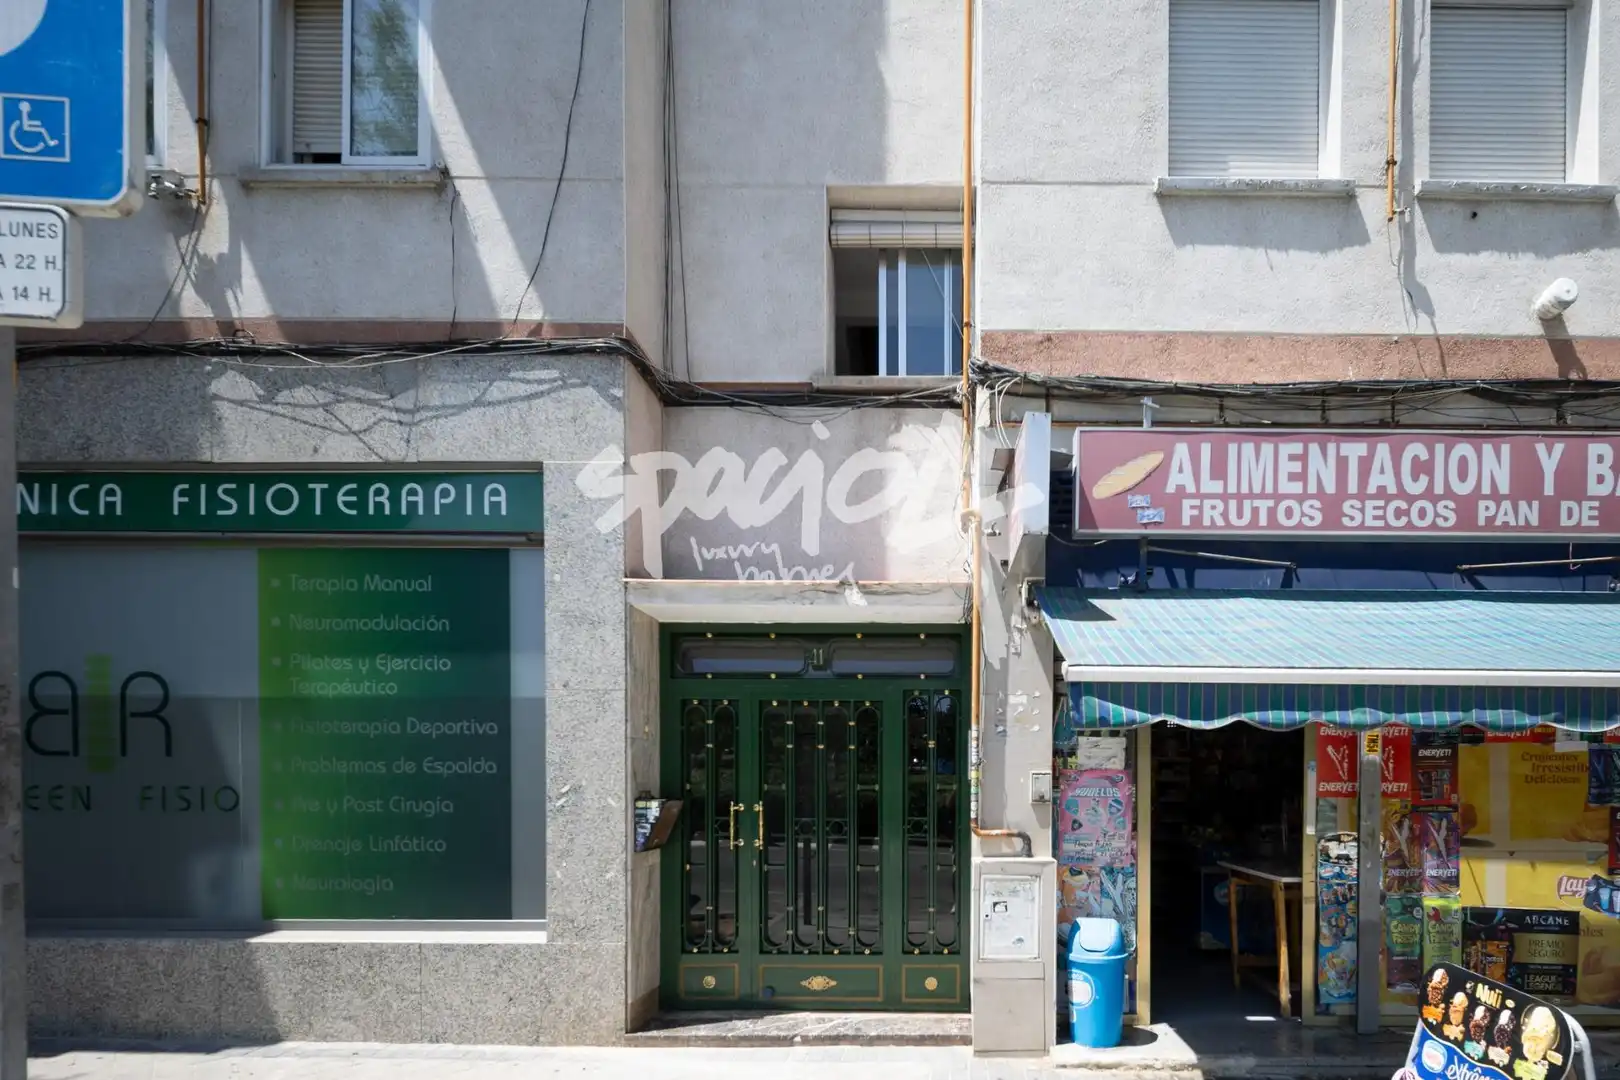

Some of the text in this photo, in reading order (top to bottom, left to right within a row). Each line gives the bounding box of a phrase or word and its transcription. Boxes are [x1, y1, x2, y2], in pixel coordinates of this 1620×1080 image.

[14, 253, 37, 270] 22
[11, 285, 30, 301] 14
[1165, 441, 1511, 496] ALIMENTACION
[1534, 443, 1566, 496] Y
[172, 482, 507, 516] FISIOTERAPIA
[1181, 498, 1601, 527] FRUTOS SECOS PAN DE
[290, 574, 432, 595] Terapia Manual
[289, 614, 450, 632] Neuromodulación
[290, 653, 452, 675] Pilates y Ejercicio
[290, 677, 399, 698] Terapéutico
[291, 717, 499, 738] Fisioterapia Deportiva
[291, 756, 498, 778] Problemas de Espalda
[139, 784, 240, 812] FISIO
[326, 800, 338, 817] y
[343, 795, 384, 813] Post
[389, 795, 455, 818] Cirugía
[369, 835, 447, 852] Linfático
[1524, 914, 1570, 926] ARCANE
